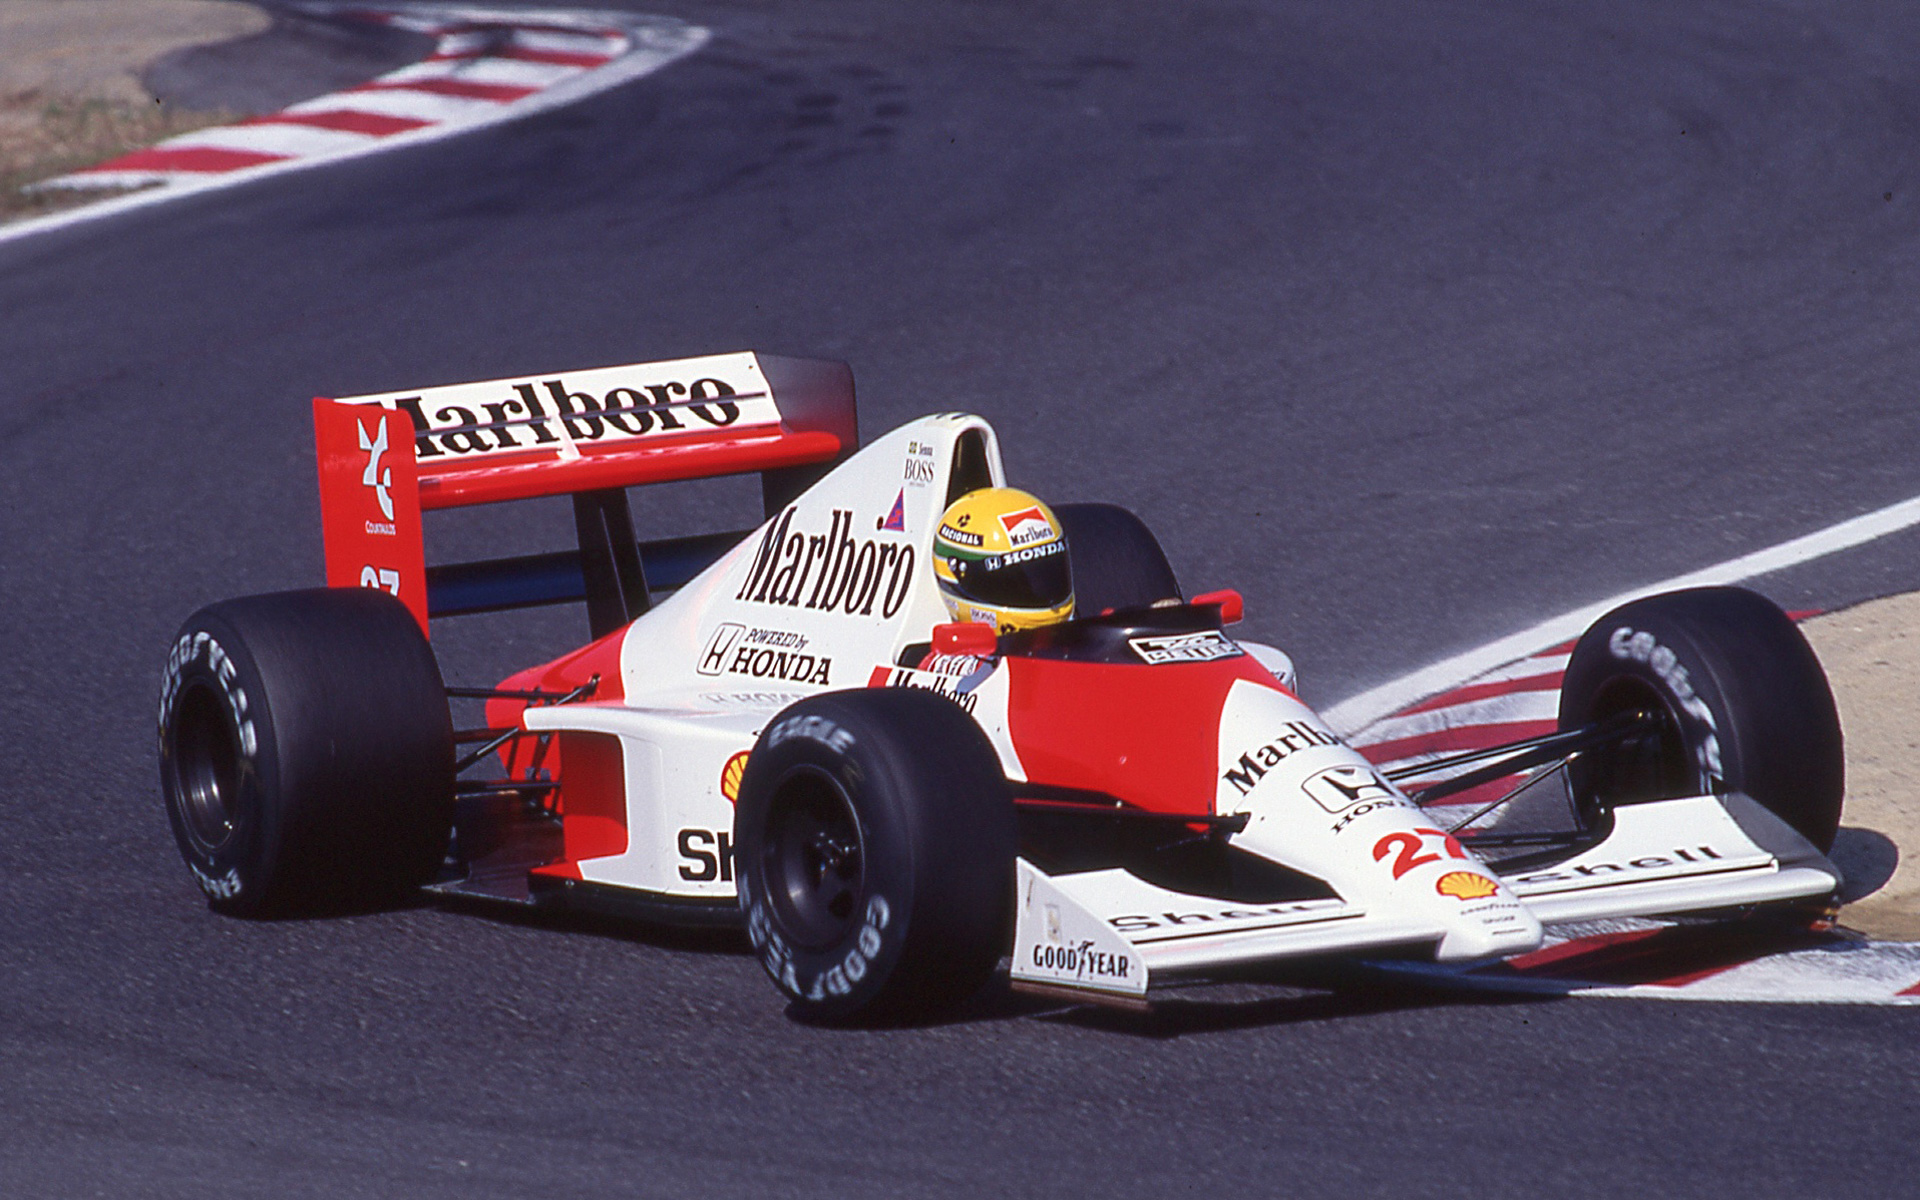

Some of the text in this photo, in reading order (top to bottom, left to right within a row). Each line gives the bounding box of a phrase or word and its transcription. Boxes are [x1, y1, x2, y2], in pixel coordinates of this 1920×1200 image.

[904, 458, 935, 483] BOSS
[1003, 541, 1066, 566] HONDA
[1011, 527, 1053, 546] Marlboro
[736, 506, 915, 619] Marlboro
[744, 628, 809, 652] POWERED by
[729, 647, 832, 686] HONDA
[1222, 720, 1343, 796] Marlb
[1330, 800, 1417, 835] HON
[1373, 827, 1468, 881] 27
